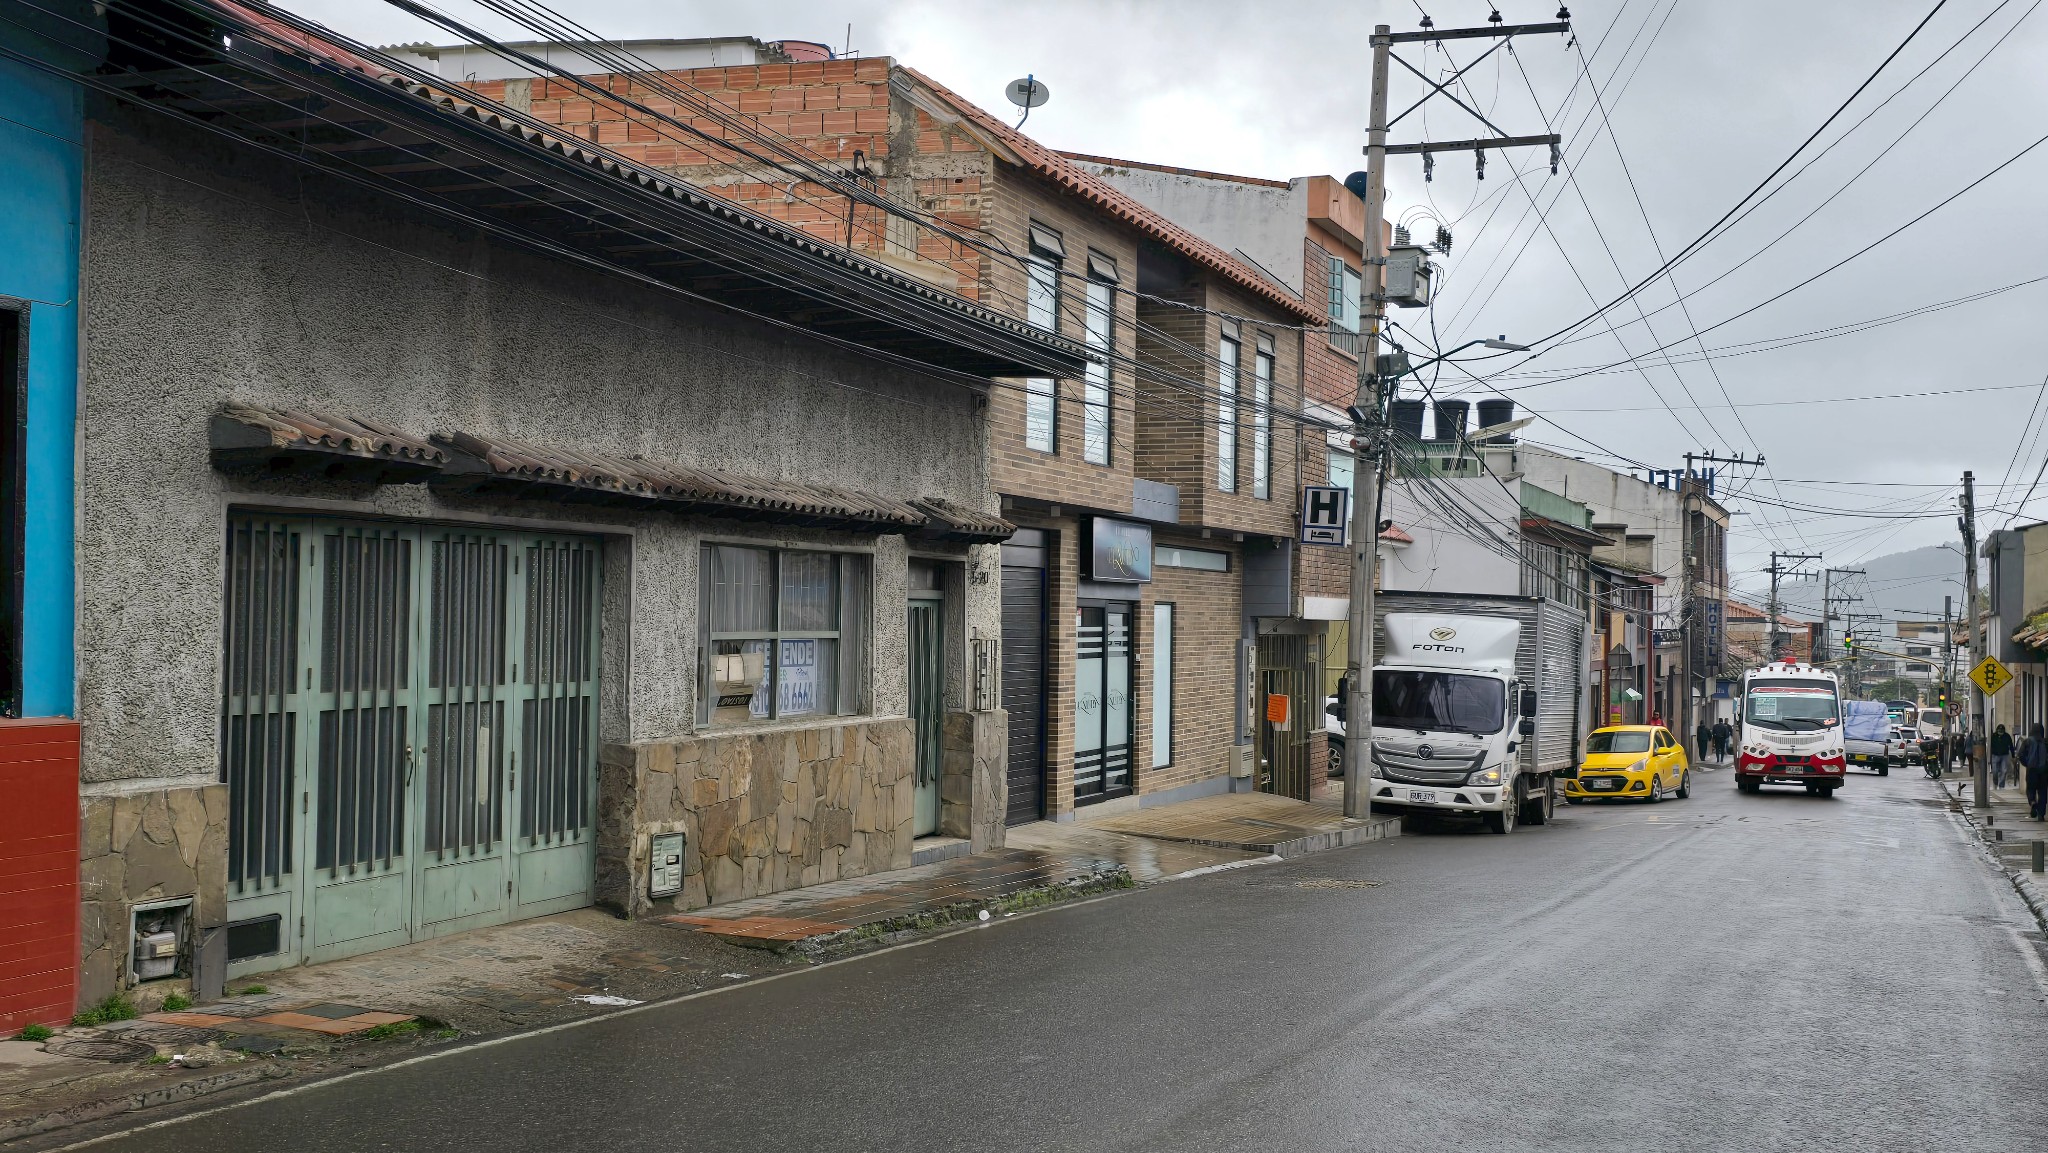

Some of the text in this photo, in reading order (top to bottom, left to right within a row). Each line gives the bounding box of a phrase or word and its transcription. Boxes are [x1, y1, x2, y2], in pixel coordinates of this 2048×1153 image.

[1309, 490, 1339, 525] H
[1708, 603, 1718, 657] HOTEL
[780, 641, 814, 666] ENDE
[1412, 644, 1465, 654] FOTON
